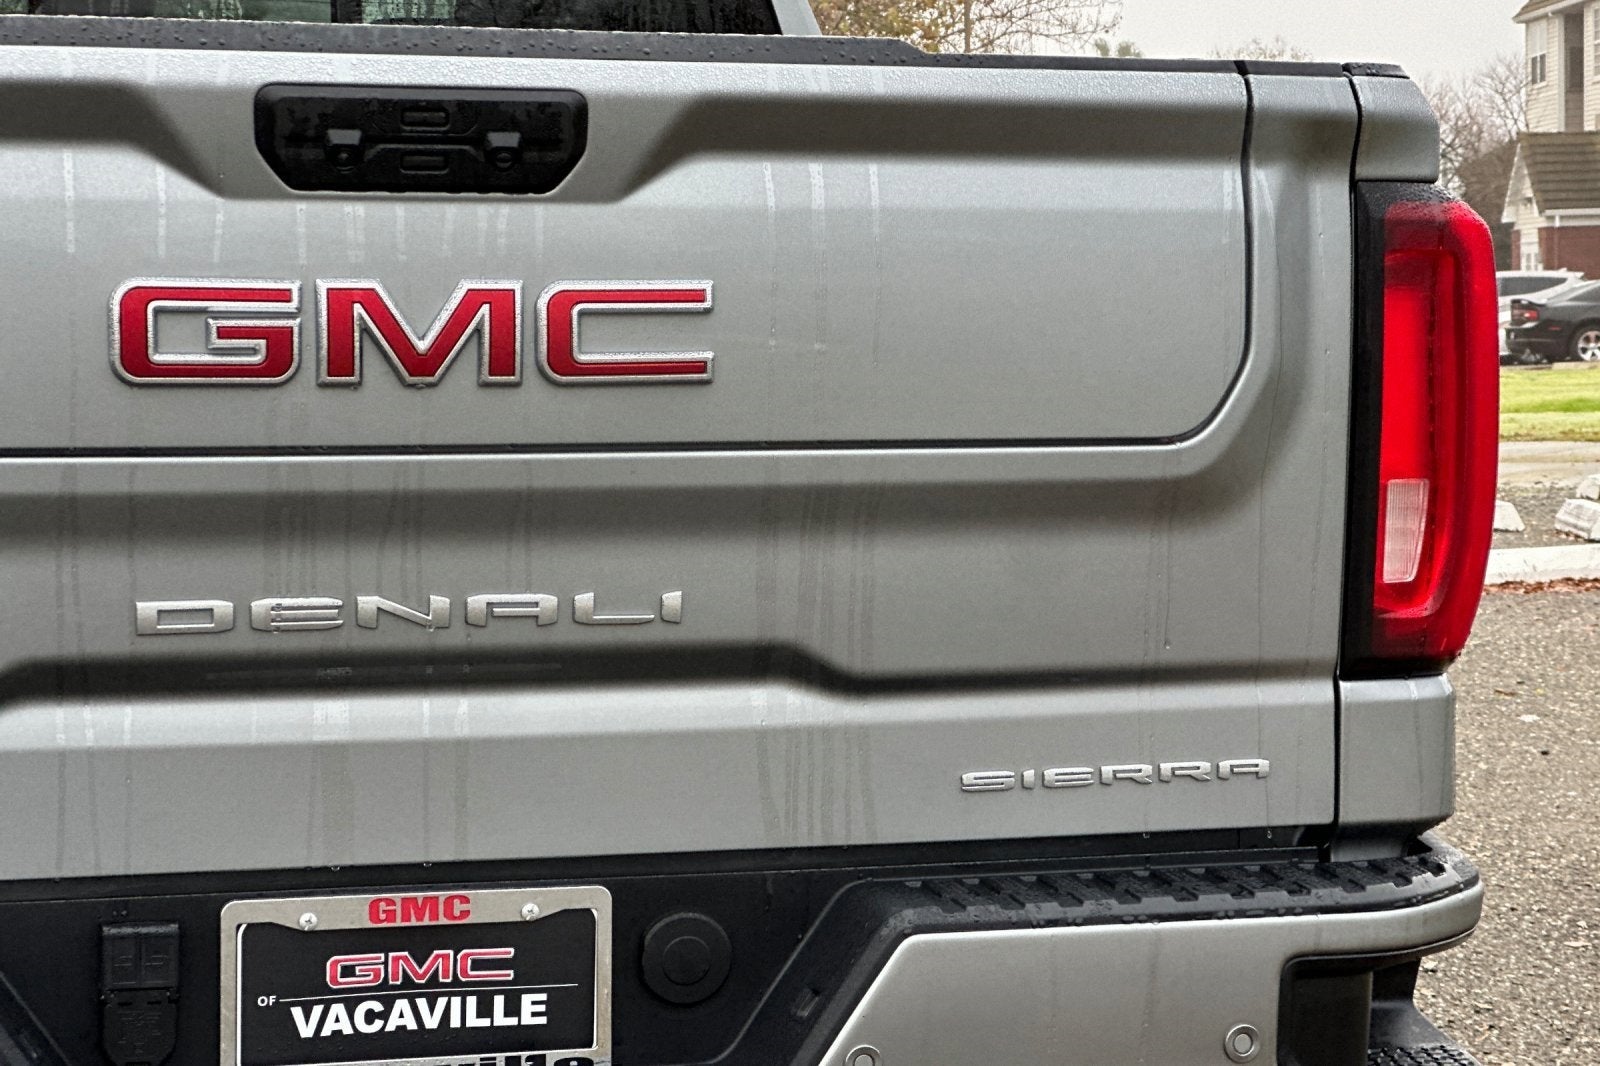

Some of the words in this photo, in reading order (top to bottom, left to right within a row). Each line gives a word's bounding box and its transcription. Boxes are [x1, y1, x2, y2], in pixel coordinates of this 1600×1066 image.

[110, 277, 714, 387] GMC
[135, 590, 683, 636] DENALI
[960, 758, 1270, 792] SIERRA
[368, 894, 472, 925] GMC
[326, 948, 515, 989] GMC
[257, 995, 277, 1007] OF
[290, 993, 548, 1039] VACAVILLE
